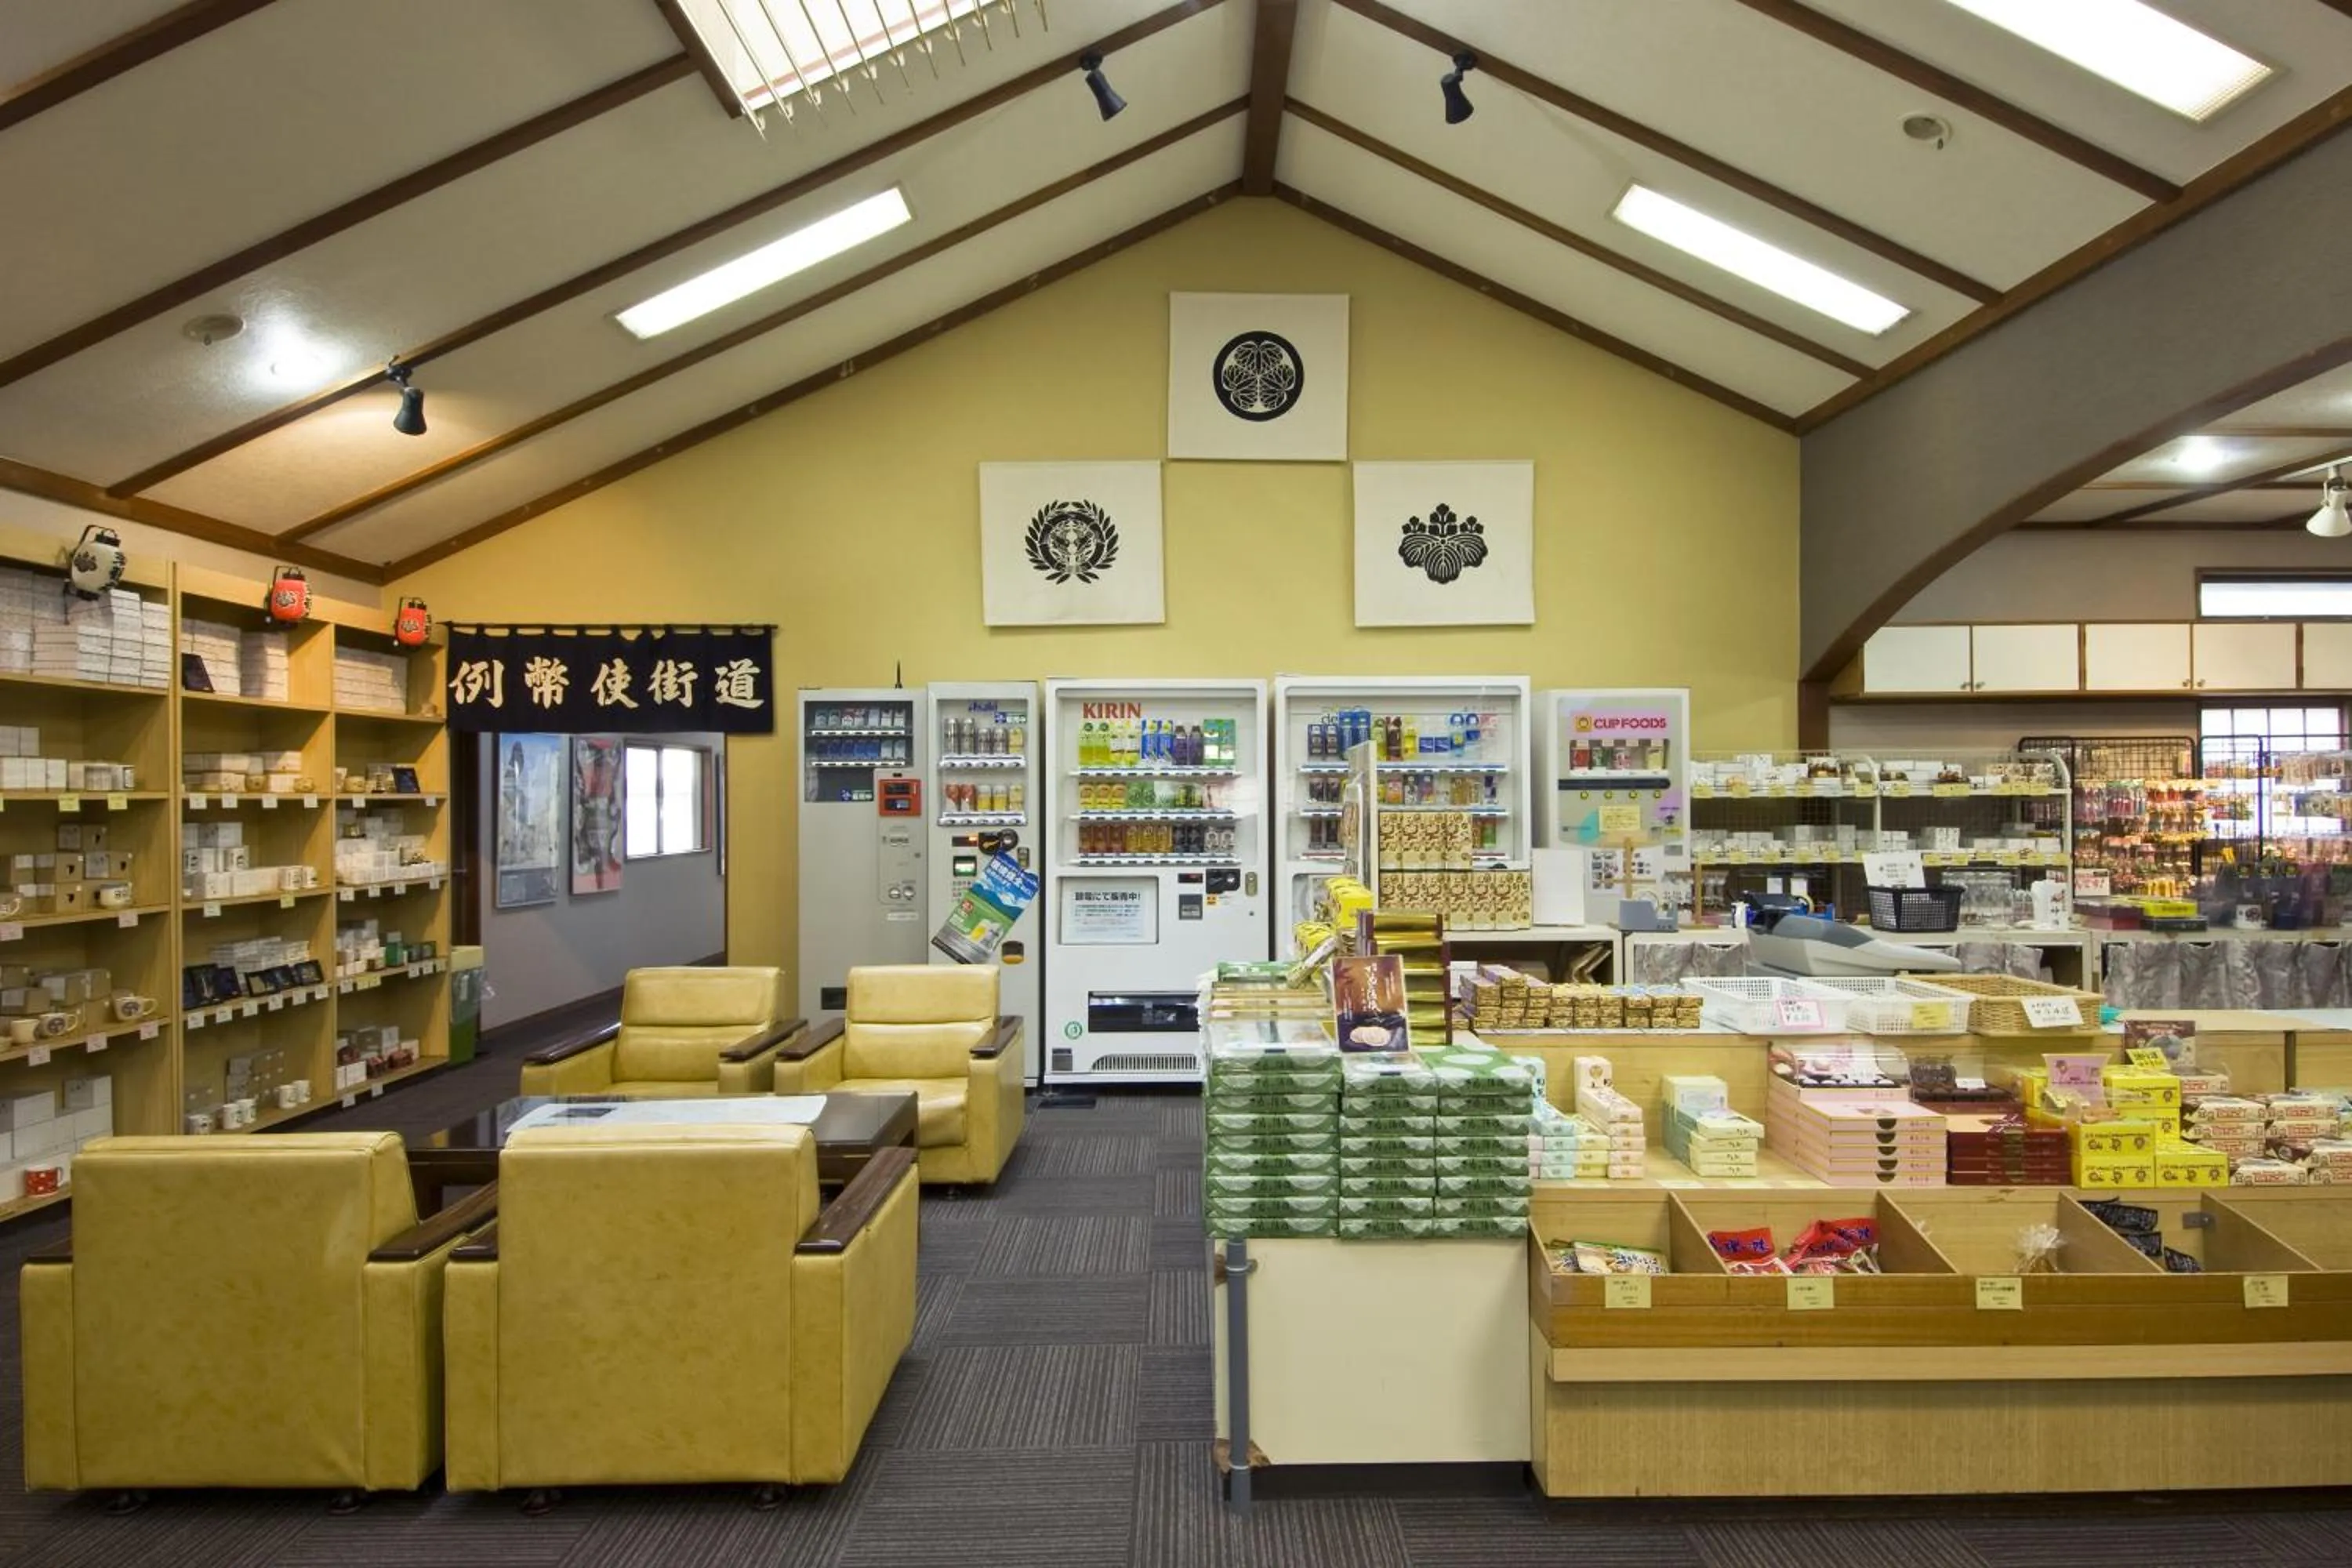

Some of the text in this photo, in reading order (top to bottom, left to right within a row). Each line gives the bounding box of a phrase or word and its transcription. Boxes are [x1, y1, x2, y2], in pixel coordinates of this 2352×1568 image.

[448, 656, 766, 710] 例幣使街道
[1083, 702, 1142, 719] KIRIN
[1593, 717, 1667, 729] CUP FOODS
